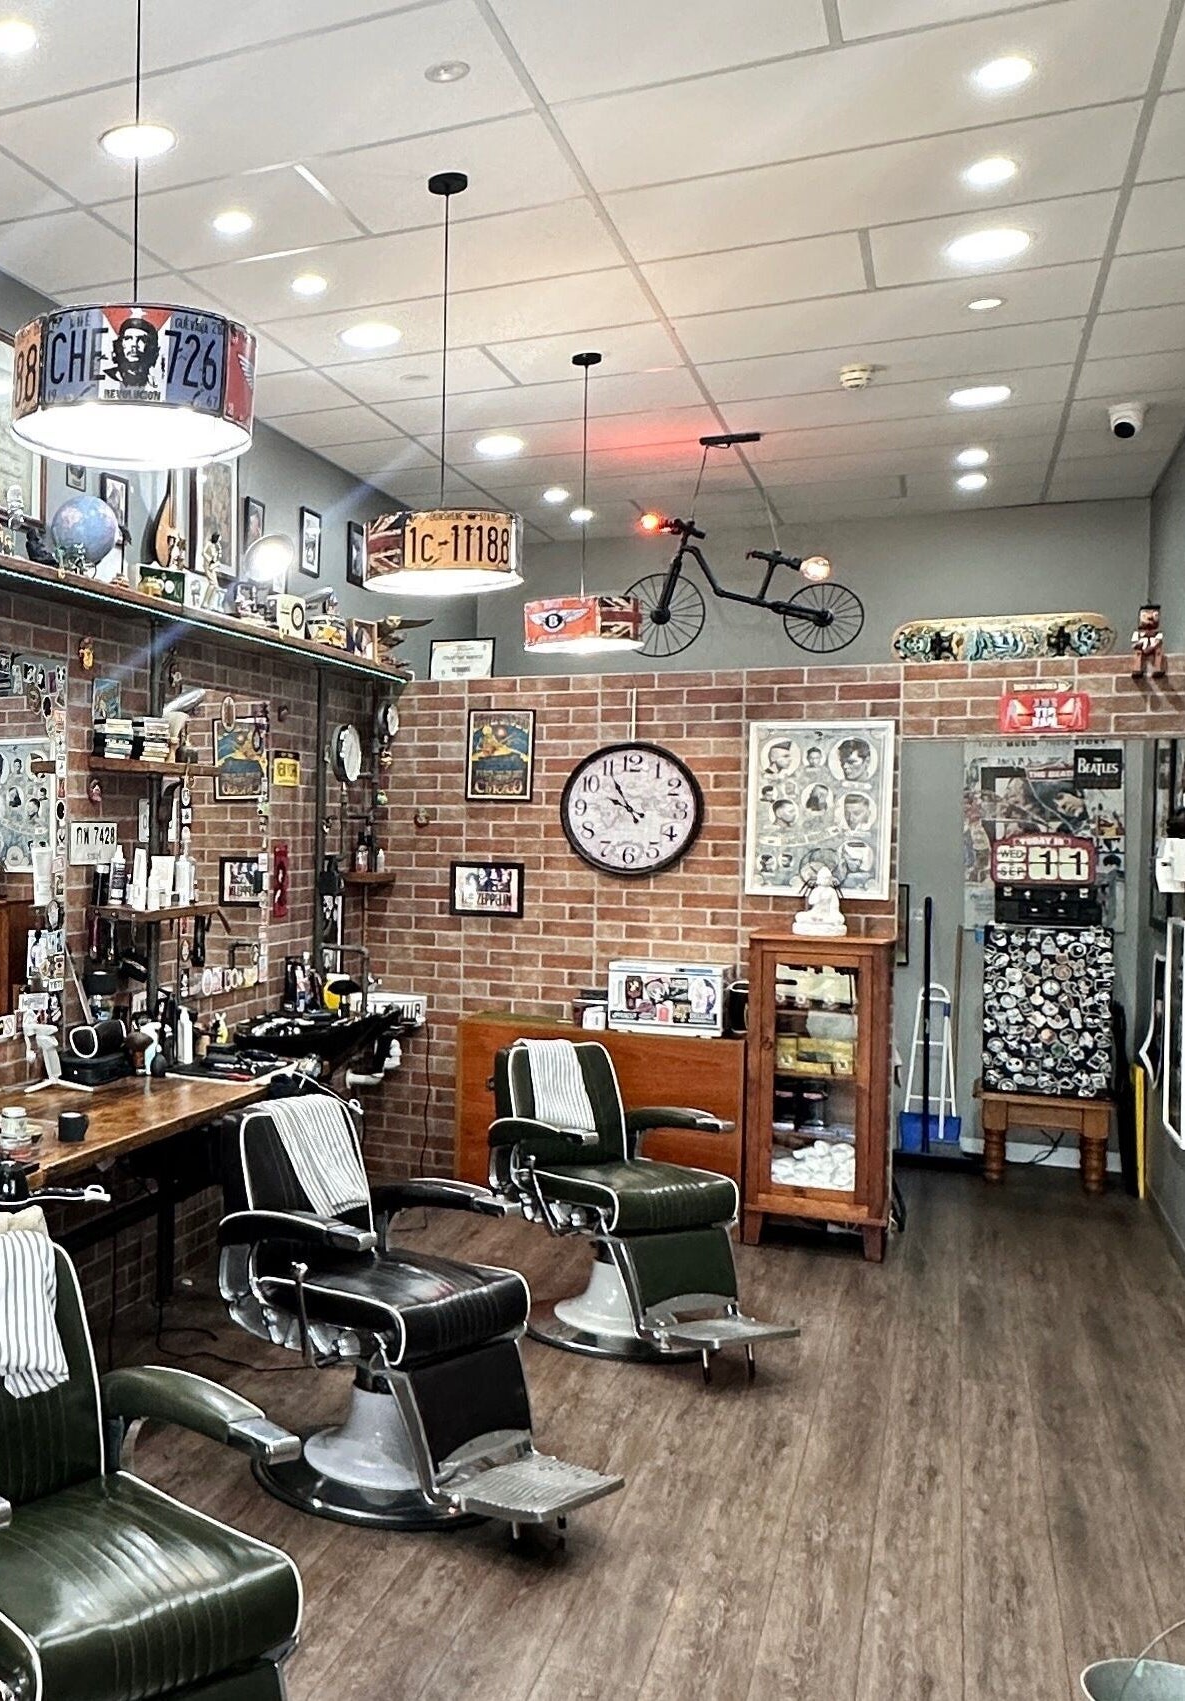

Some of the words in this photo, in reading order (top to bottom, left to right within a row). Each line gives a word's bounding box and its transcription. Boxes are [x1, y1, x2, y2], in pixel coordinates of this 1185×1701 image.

[50, 327, 109, 385] CHE
[165, 330, 217, 391] 726
[603, 759, 614, 776] 11
[622, 754, 643, 772] 12
[655, 761, 661, 779] 1
[1077, 757, 1119, 776] BEATLES
[582, 775, 600, 793] 10
[667, 778, 682, 796] 2
[574, 799, 587, 816] 9
[673, 801, 688, 820] 3
[94, 826, 115, 845] 7428
[581, 822, 595, 839] 8
[662, 825, 678, 842] 4
[600, 840, 612, 857] 7
[622, 846, 635, 864] 6
[646, 841, 660, 859] 5
[1000, 849, 1024, 858] WED
[1000, 867, 1024, 876] SEP
